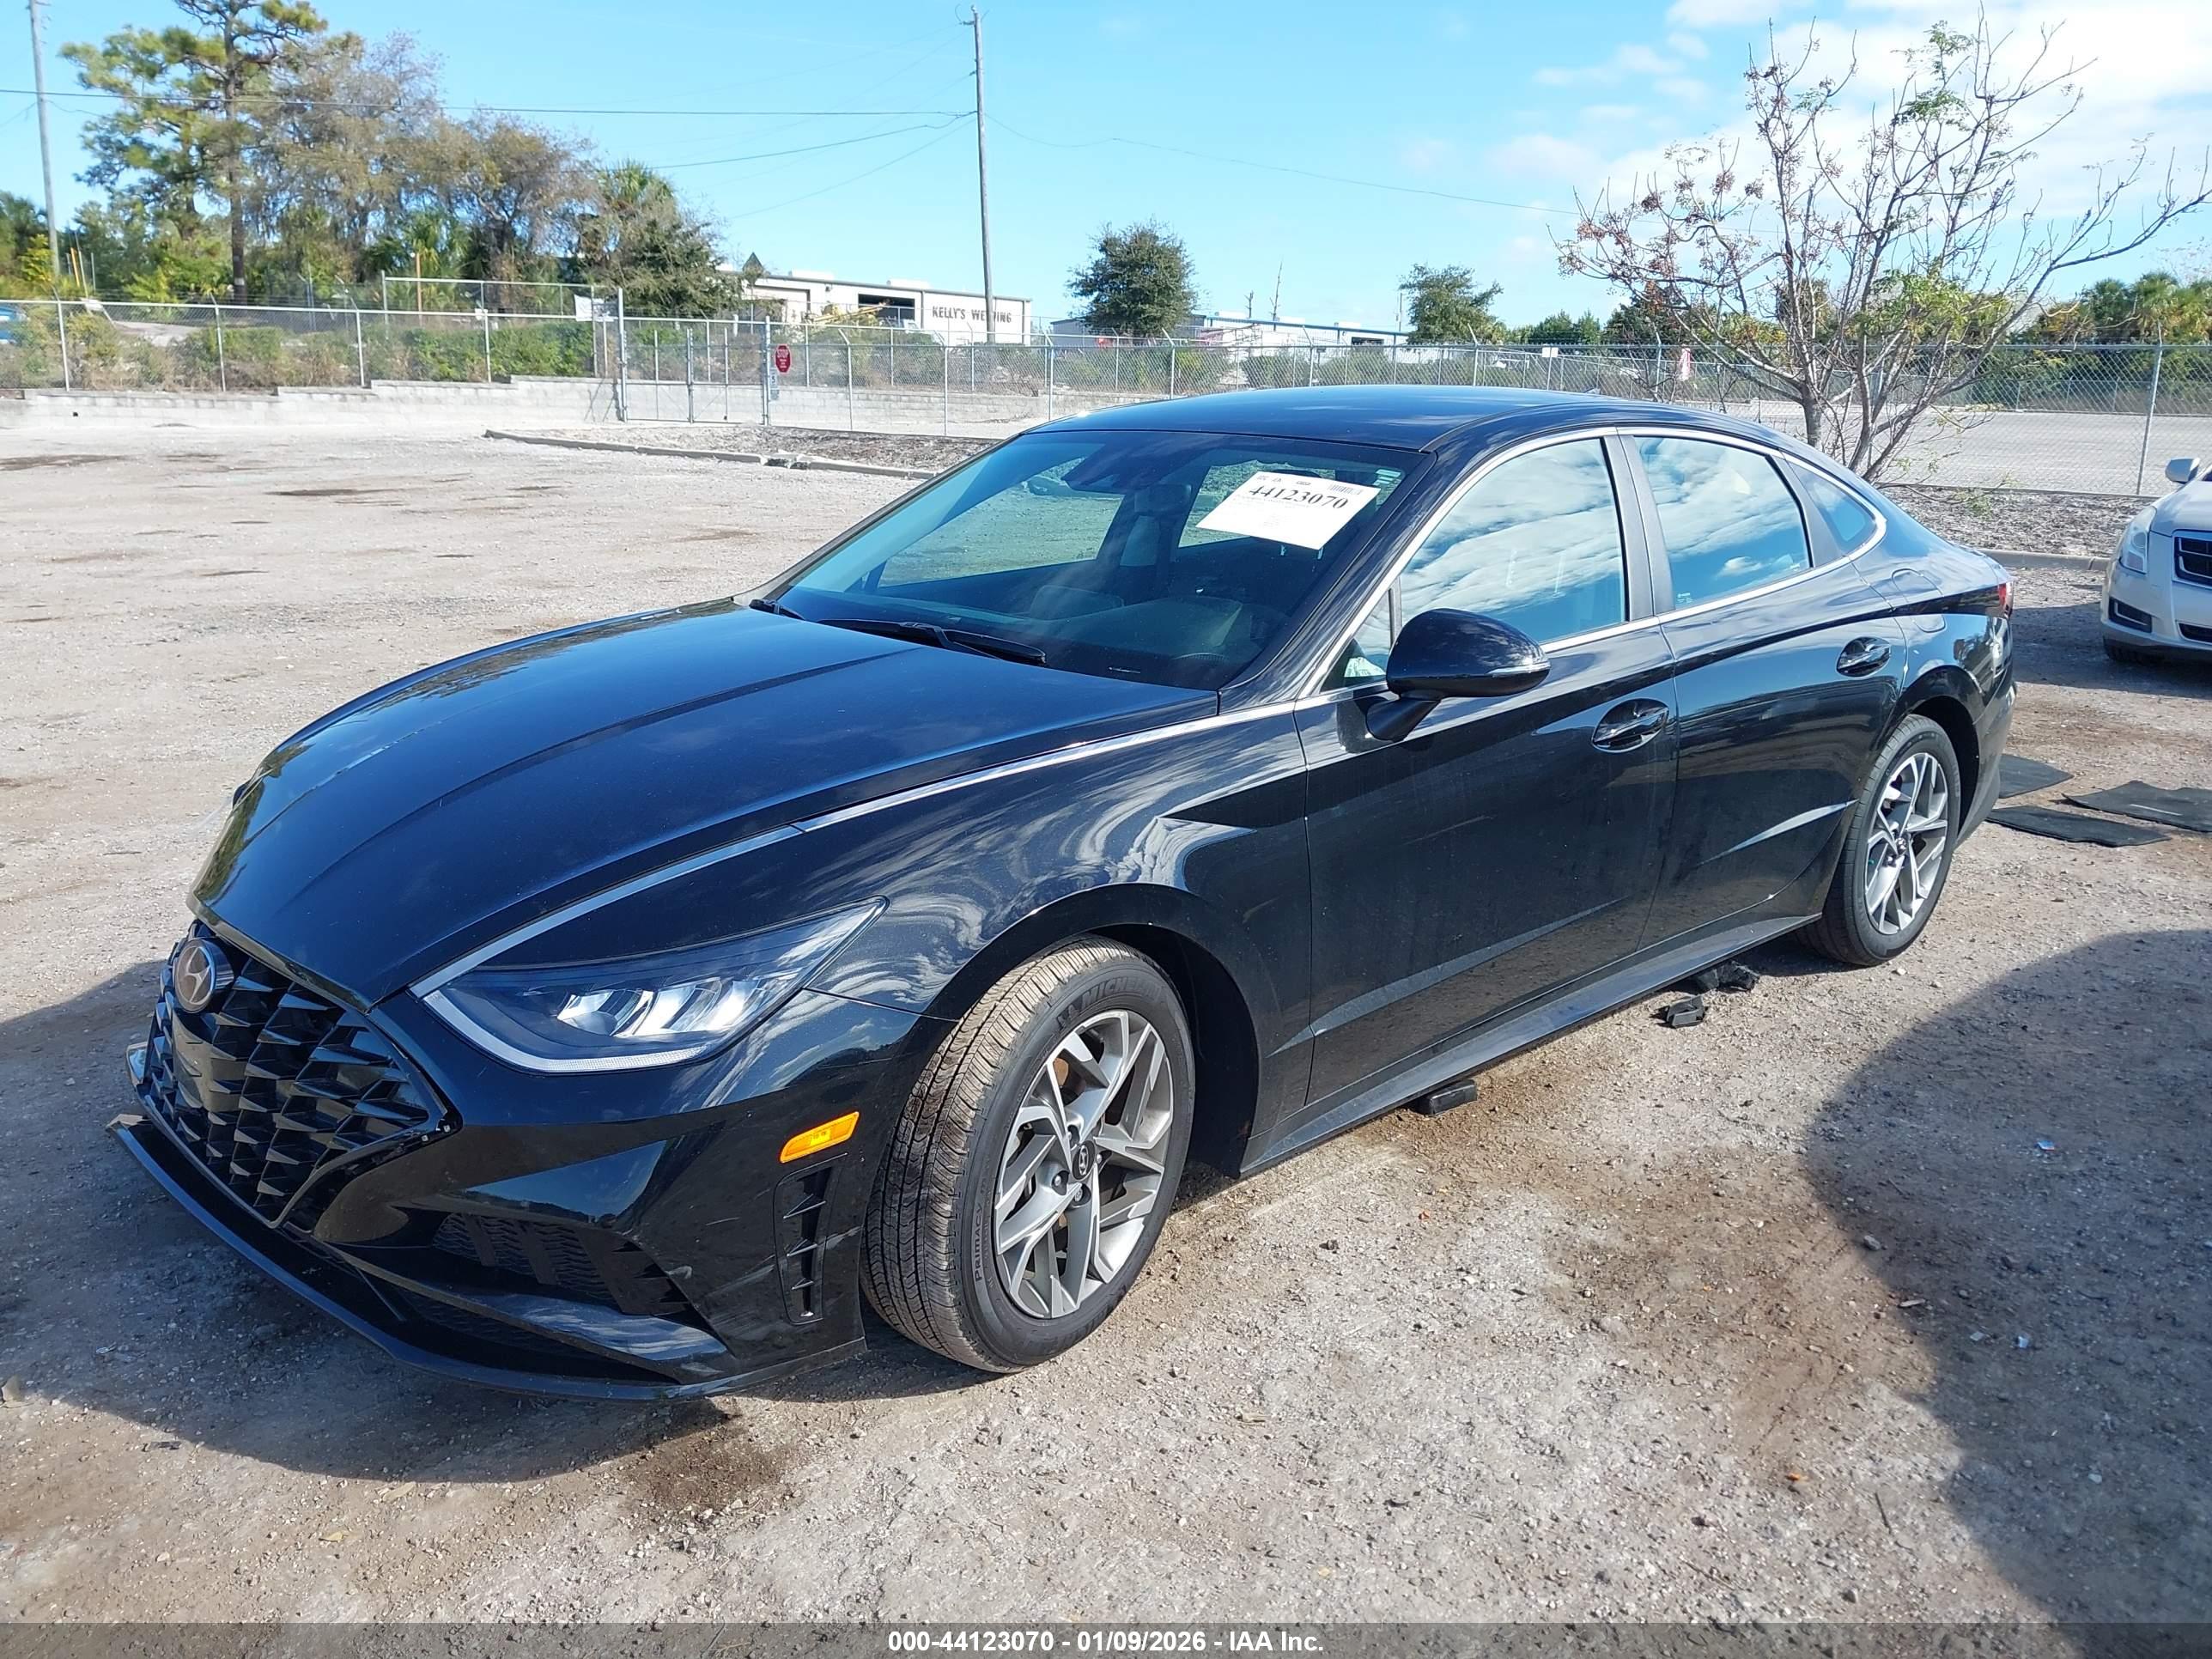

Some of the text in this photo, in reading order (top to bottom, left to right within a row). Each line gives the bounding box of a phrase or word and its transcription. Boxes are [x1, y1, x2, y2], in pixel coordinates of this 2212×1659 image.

[933, 306, 1012, 324] KELLY'S WEING
[1249, 485, 1348, 509] 44123070
[974, 1203, 984, 1282] PRIMACY
